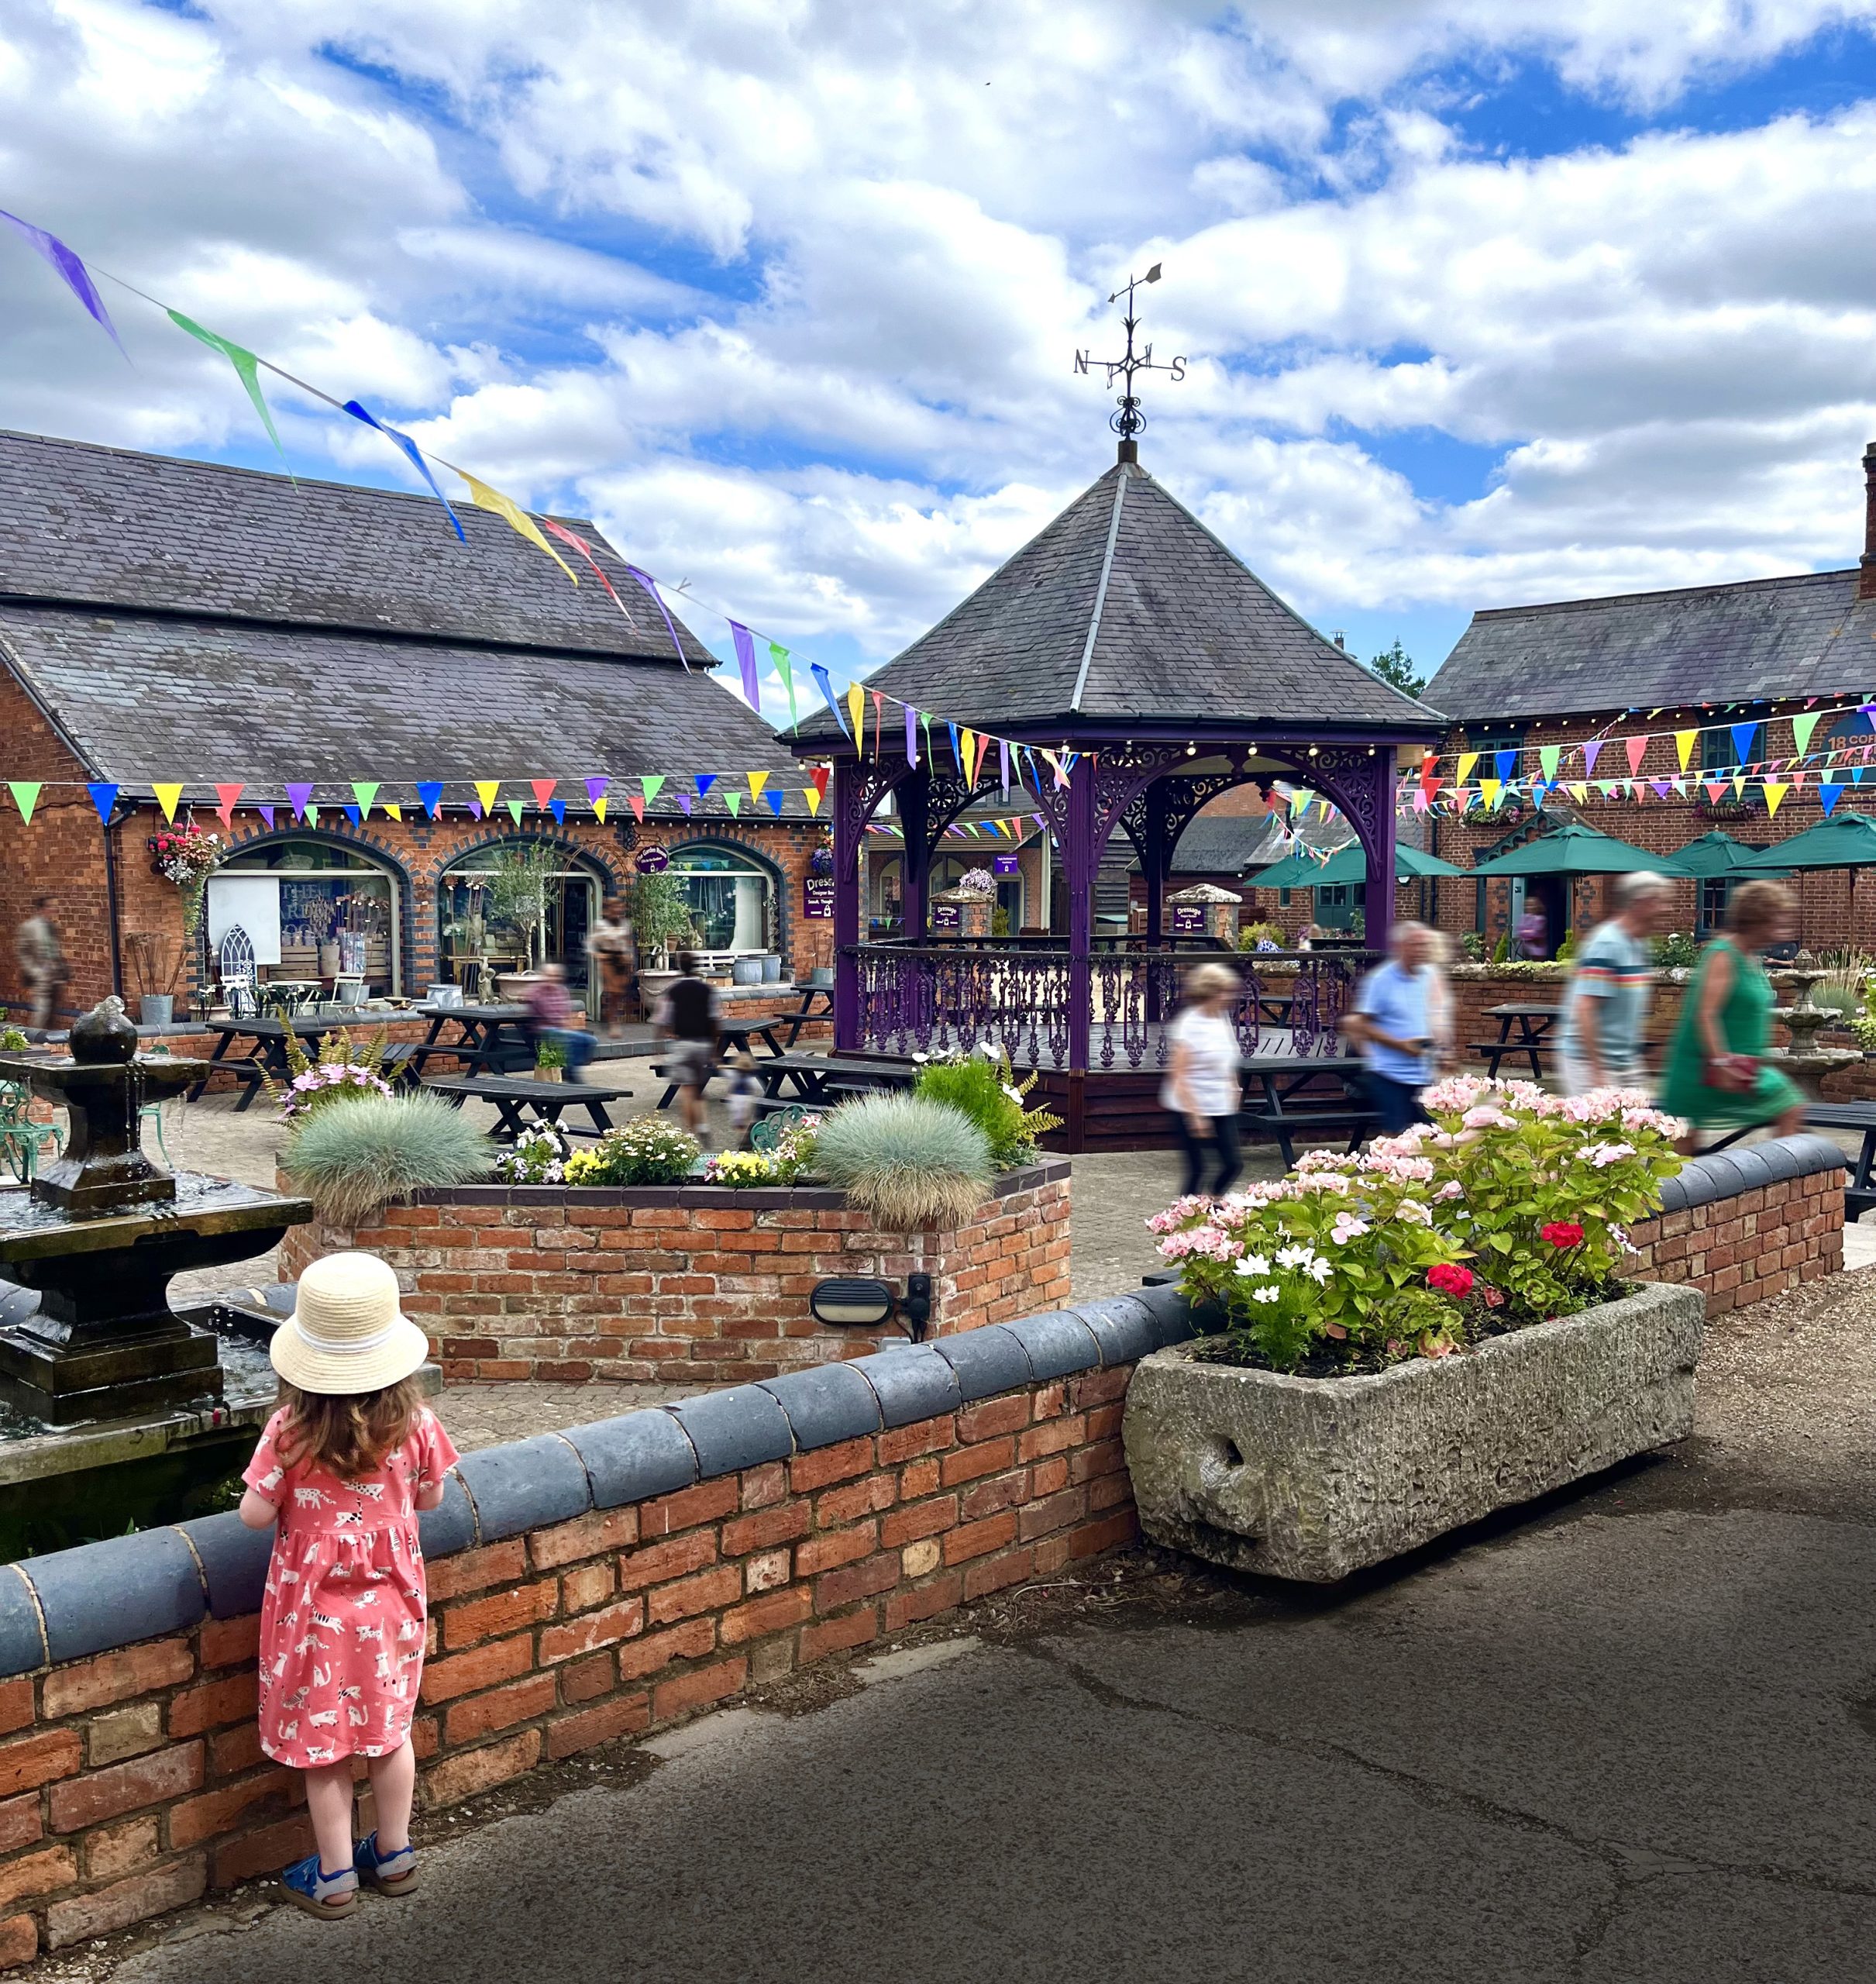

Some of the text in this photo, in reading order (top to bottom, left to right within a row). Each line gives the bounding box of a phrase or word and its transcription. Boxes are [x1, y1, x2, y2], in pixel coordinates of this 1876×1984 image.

[1073, 349, 1089, 374] N
[1171, 356, 1186, 381] S
[1828, 736, 1847, 750] 18
[643, 846, 656, 856] Garden
